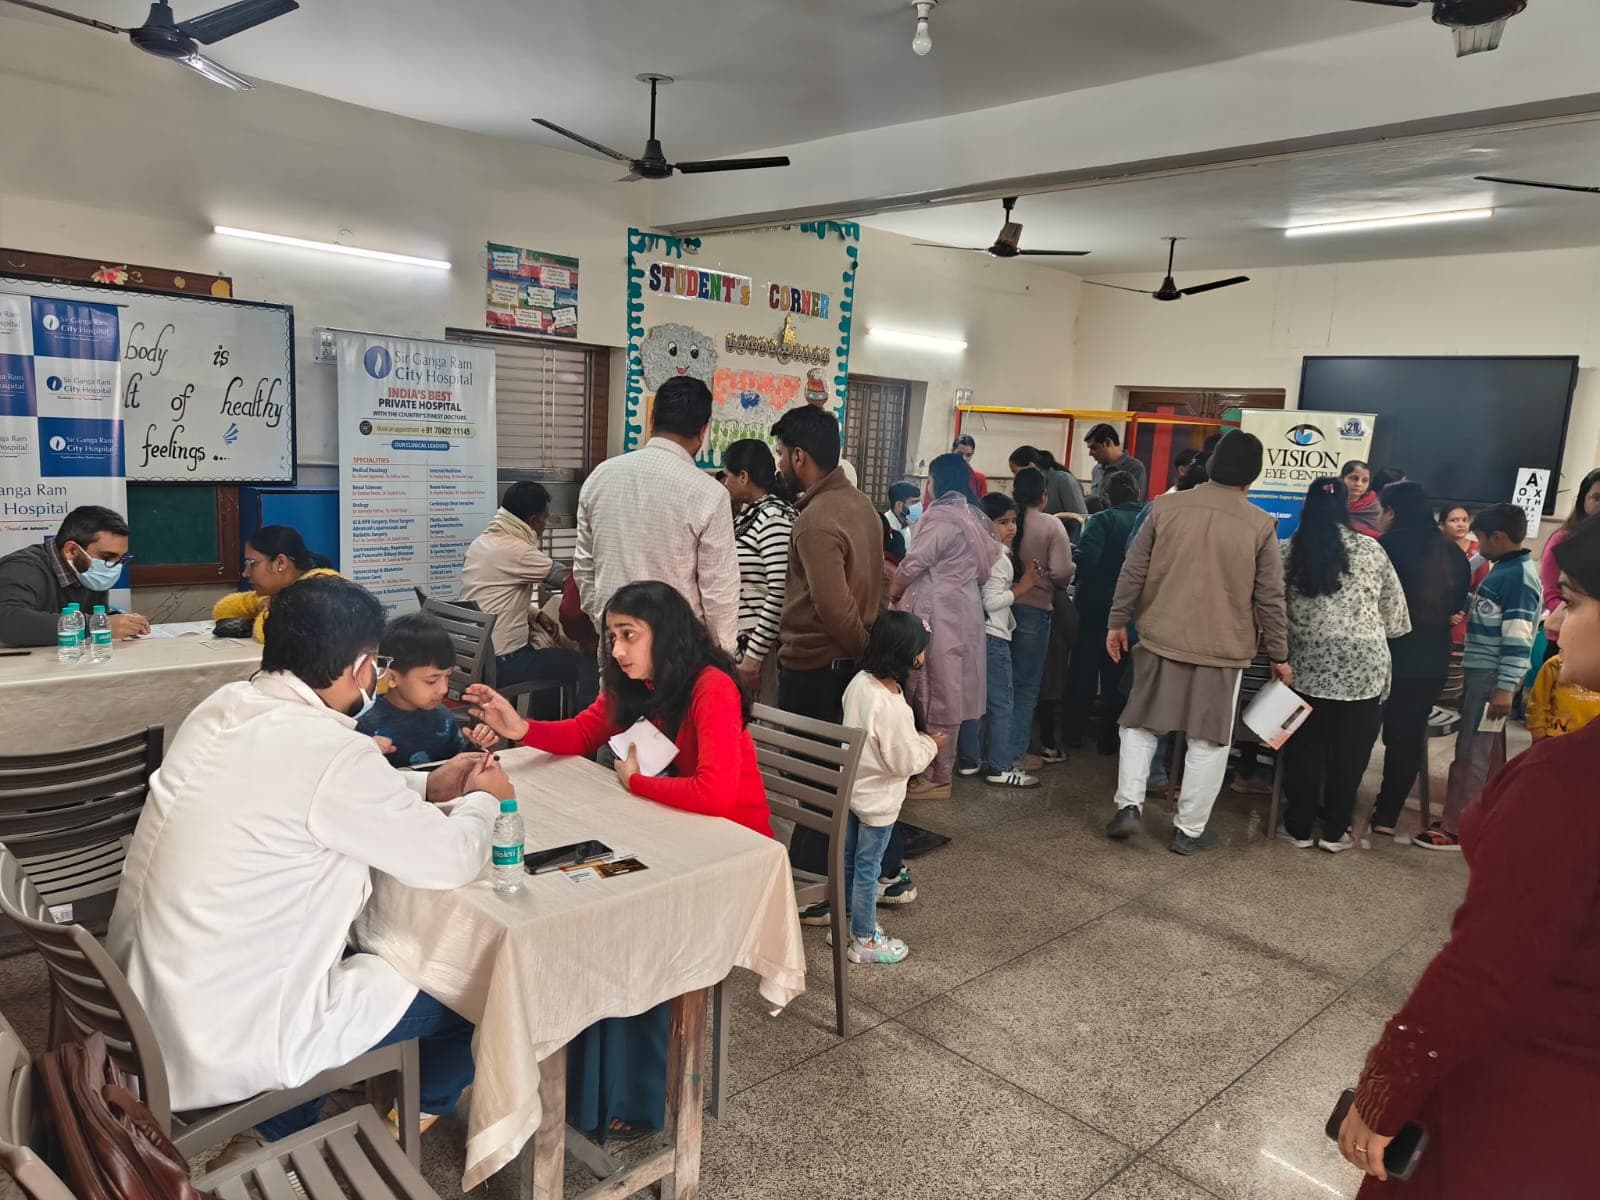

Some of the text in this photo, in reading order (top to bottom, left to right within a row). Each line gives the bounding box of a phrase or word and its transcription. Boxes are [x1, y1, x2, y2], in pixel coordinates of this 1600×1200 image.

[769, 283, 831, 320] CORNER
[60, 324, 110, 336] City Hospital
[124, 322, 230, 377] body is
[394, 350, 473, 370] Sir Ganga Ram
[73, 377, 95, 386] Ganga
[395, 366, 473, 387] City Hospital
[64, 385, 112, 395] City Hospital
[388, 387, 453, 402] INDIA'S BEST
[122, 372, 284, 428] lt of healthy
[378, 398, 462, 412] PRIVATE HOSPITAL
[398, 411, 427, 419] COUNTRY'S
[434, 426, 452, 435] 70422
[1347, 422, 1360, 432] 28
[76, 437, 98, 445] Ganga
[139, 423, 206, 472] feelings
[66, 444, 83, 453] City
[1266, 448, 1341, 470] VISION
[1264, 468, 1287, 480] EYE
[1526, 472, 1538, 487] A
[0, 484, 67, 499] anga Ram
[1519, 487, 1542, 498] O X
[4, 501, 68, 518] Hospital
